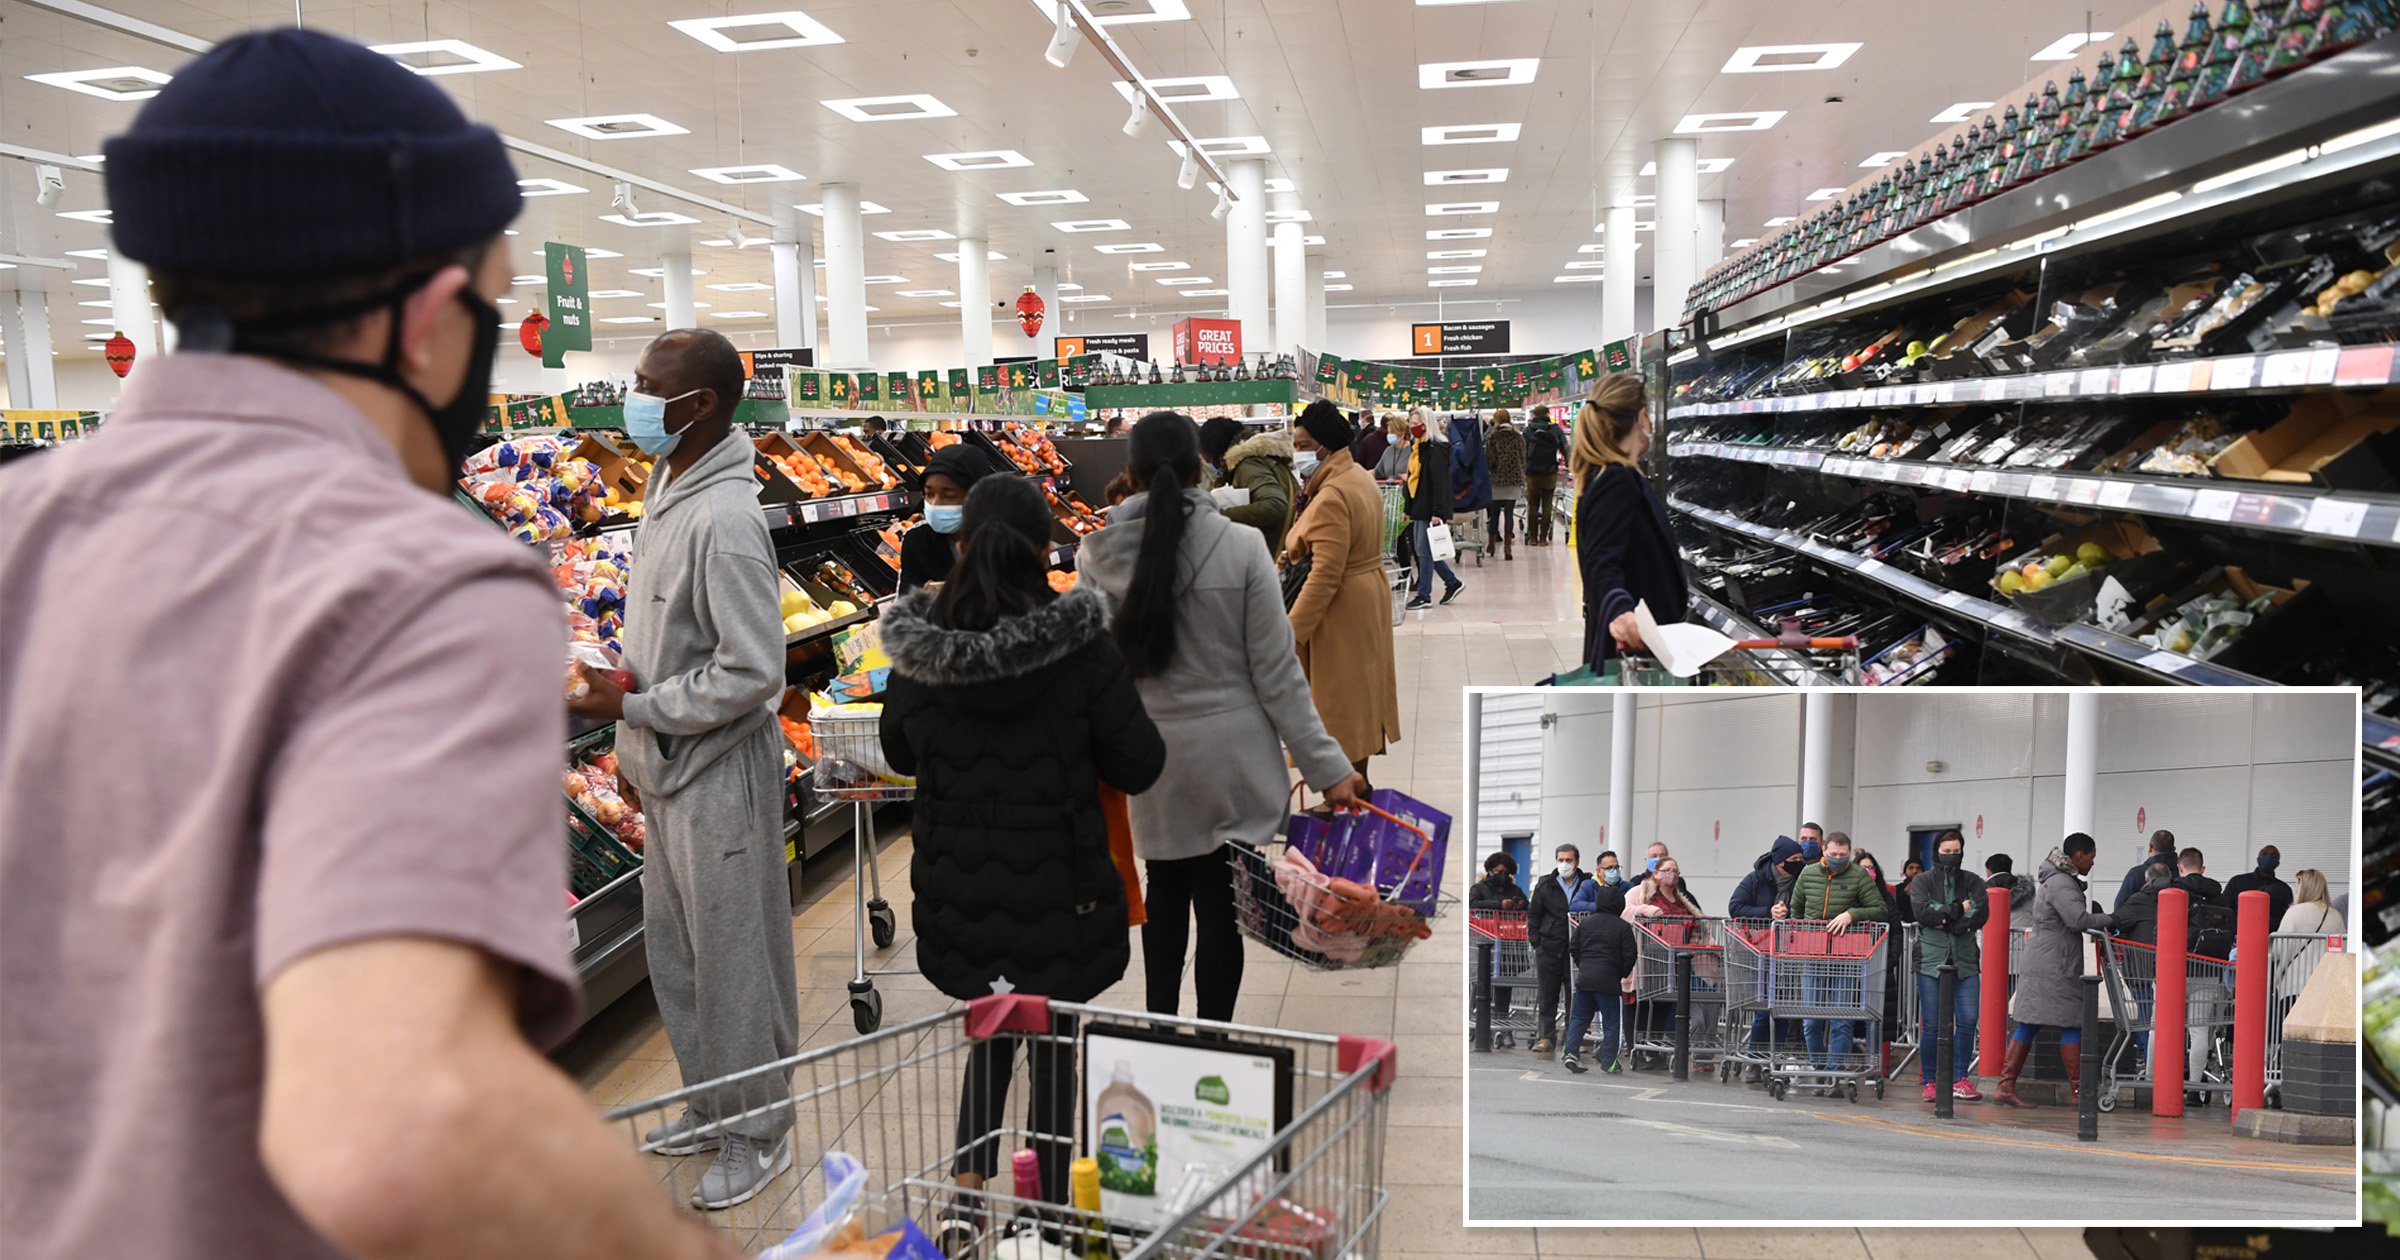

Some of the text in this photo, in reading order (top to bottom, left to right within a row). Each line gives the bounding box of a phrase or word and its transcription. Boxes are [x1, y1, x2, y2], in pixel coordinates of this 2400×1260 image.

[557, 295, 583, 309] Fruit &
[562, 314, 580, 326] nuts
[1102, 337, 1118, 345] ready
[1199, 329, 1232, 342] GREAT
[1424, 332, 1433, 347] 1
[1065, 345, 1076, 357] 2
[1197, 341, 1235, 354] PRICES
